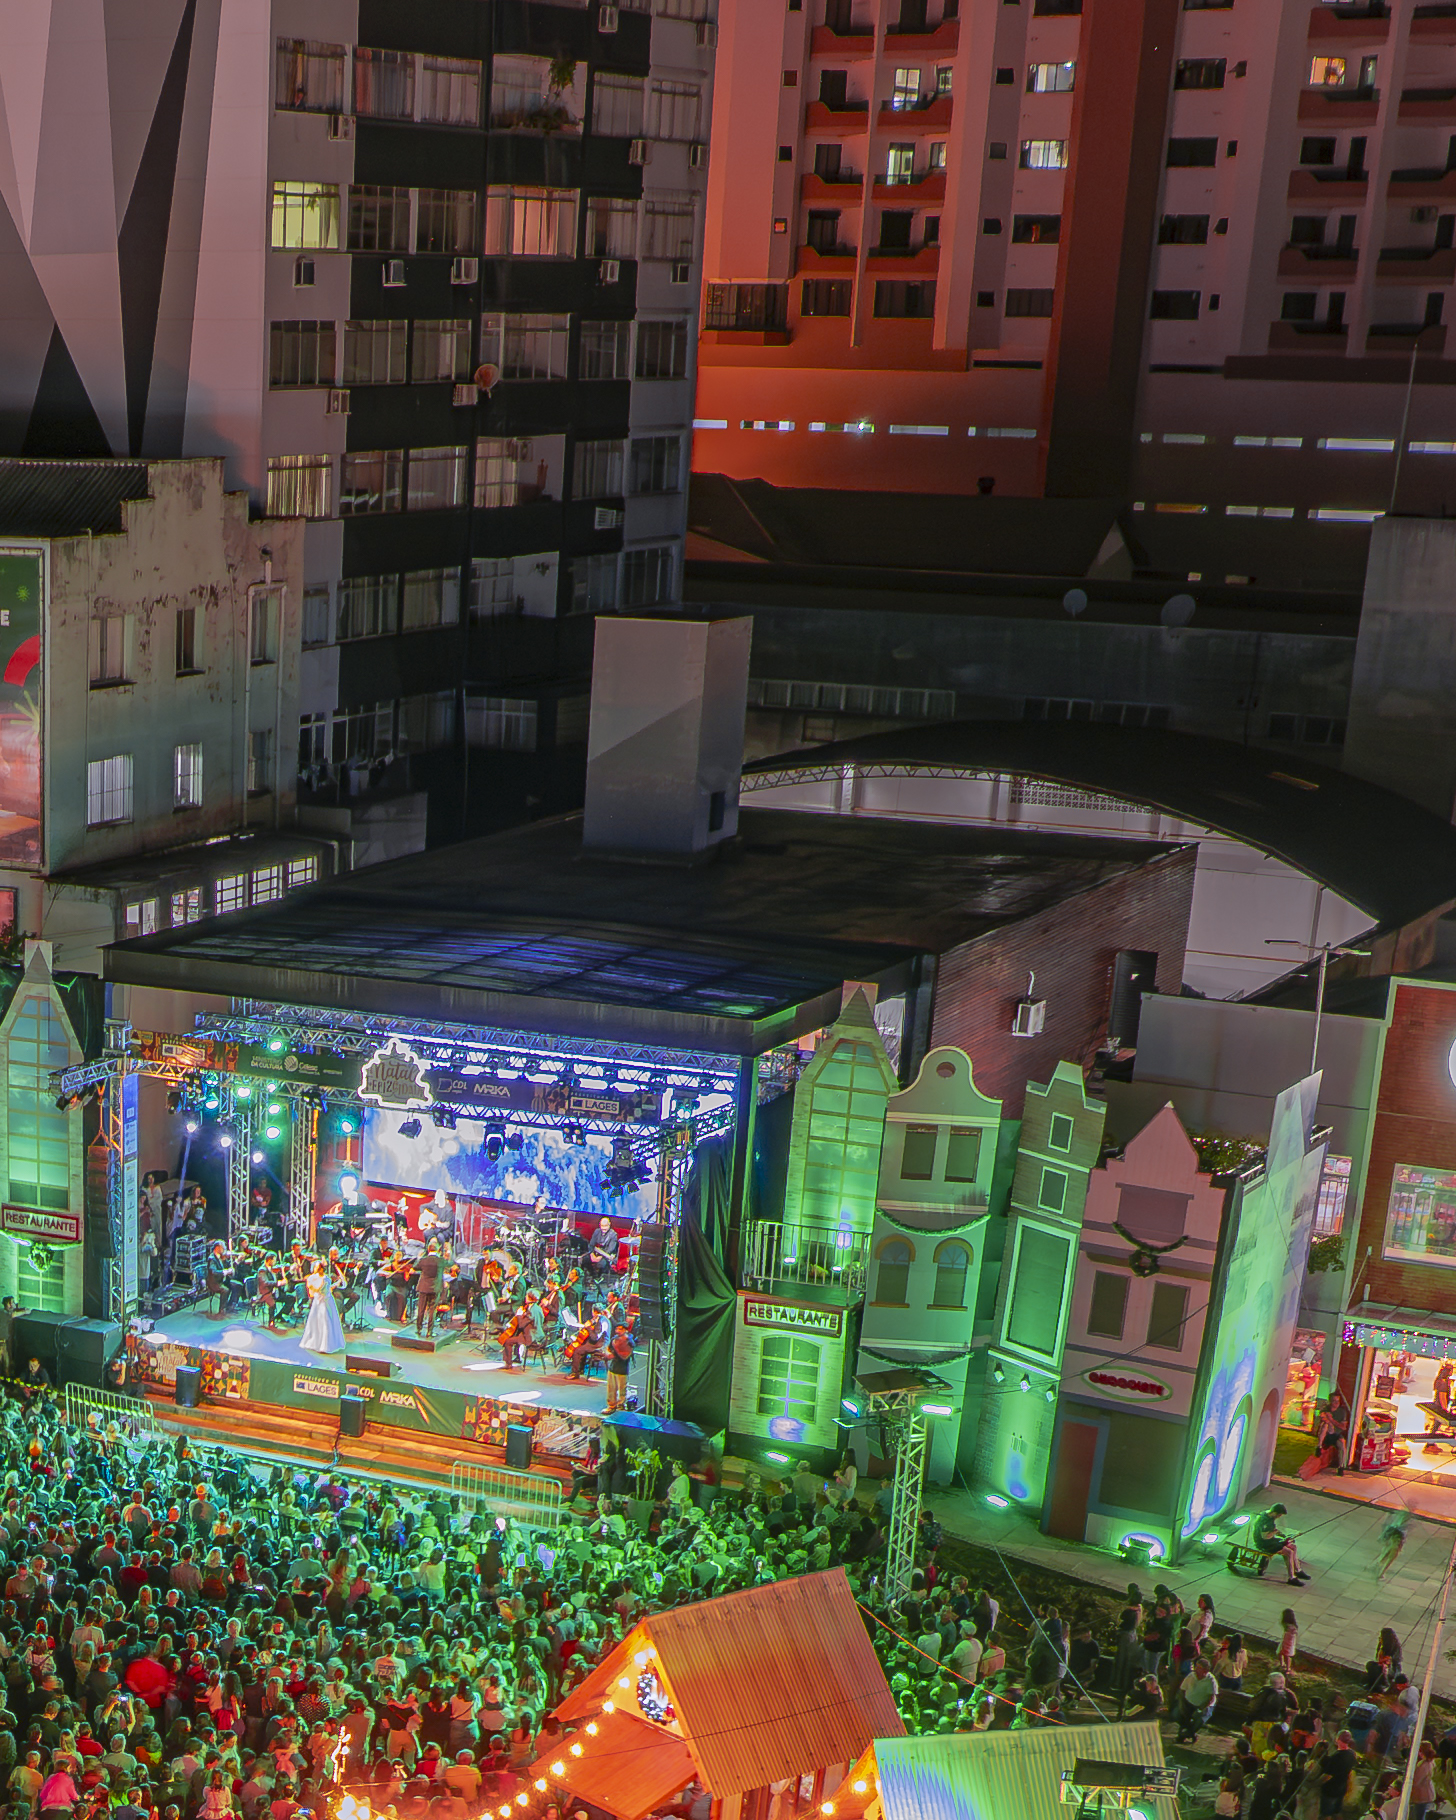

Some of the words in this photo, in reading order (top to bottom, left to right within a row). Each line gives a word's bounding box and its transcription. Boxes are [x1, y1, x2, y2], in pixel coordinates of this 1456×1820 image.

[375, 1061, 420, 1082] Natal
[585, 1100, 619, 1112] LAGES
[5, 1211, 76, 1233] RESTAURANTE
[749, 1305, 838, 1328] RESTAURANTE
[307, 1382, 338, 1396] LAGES
[359, 1386, 376, 1398] CDL
[379, 1390, 416, 1407] MRKA
